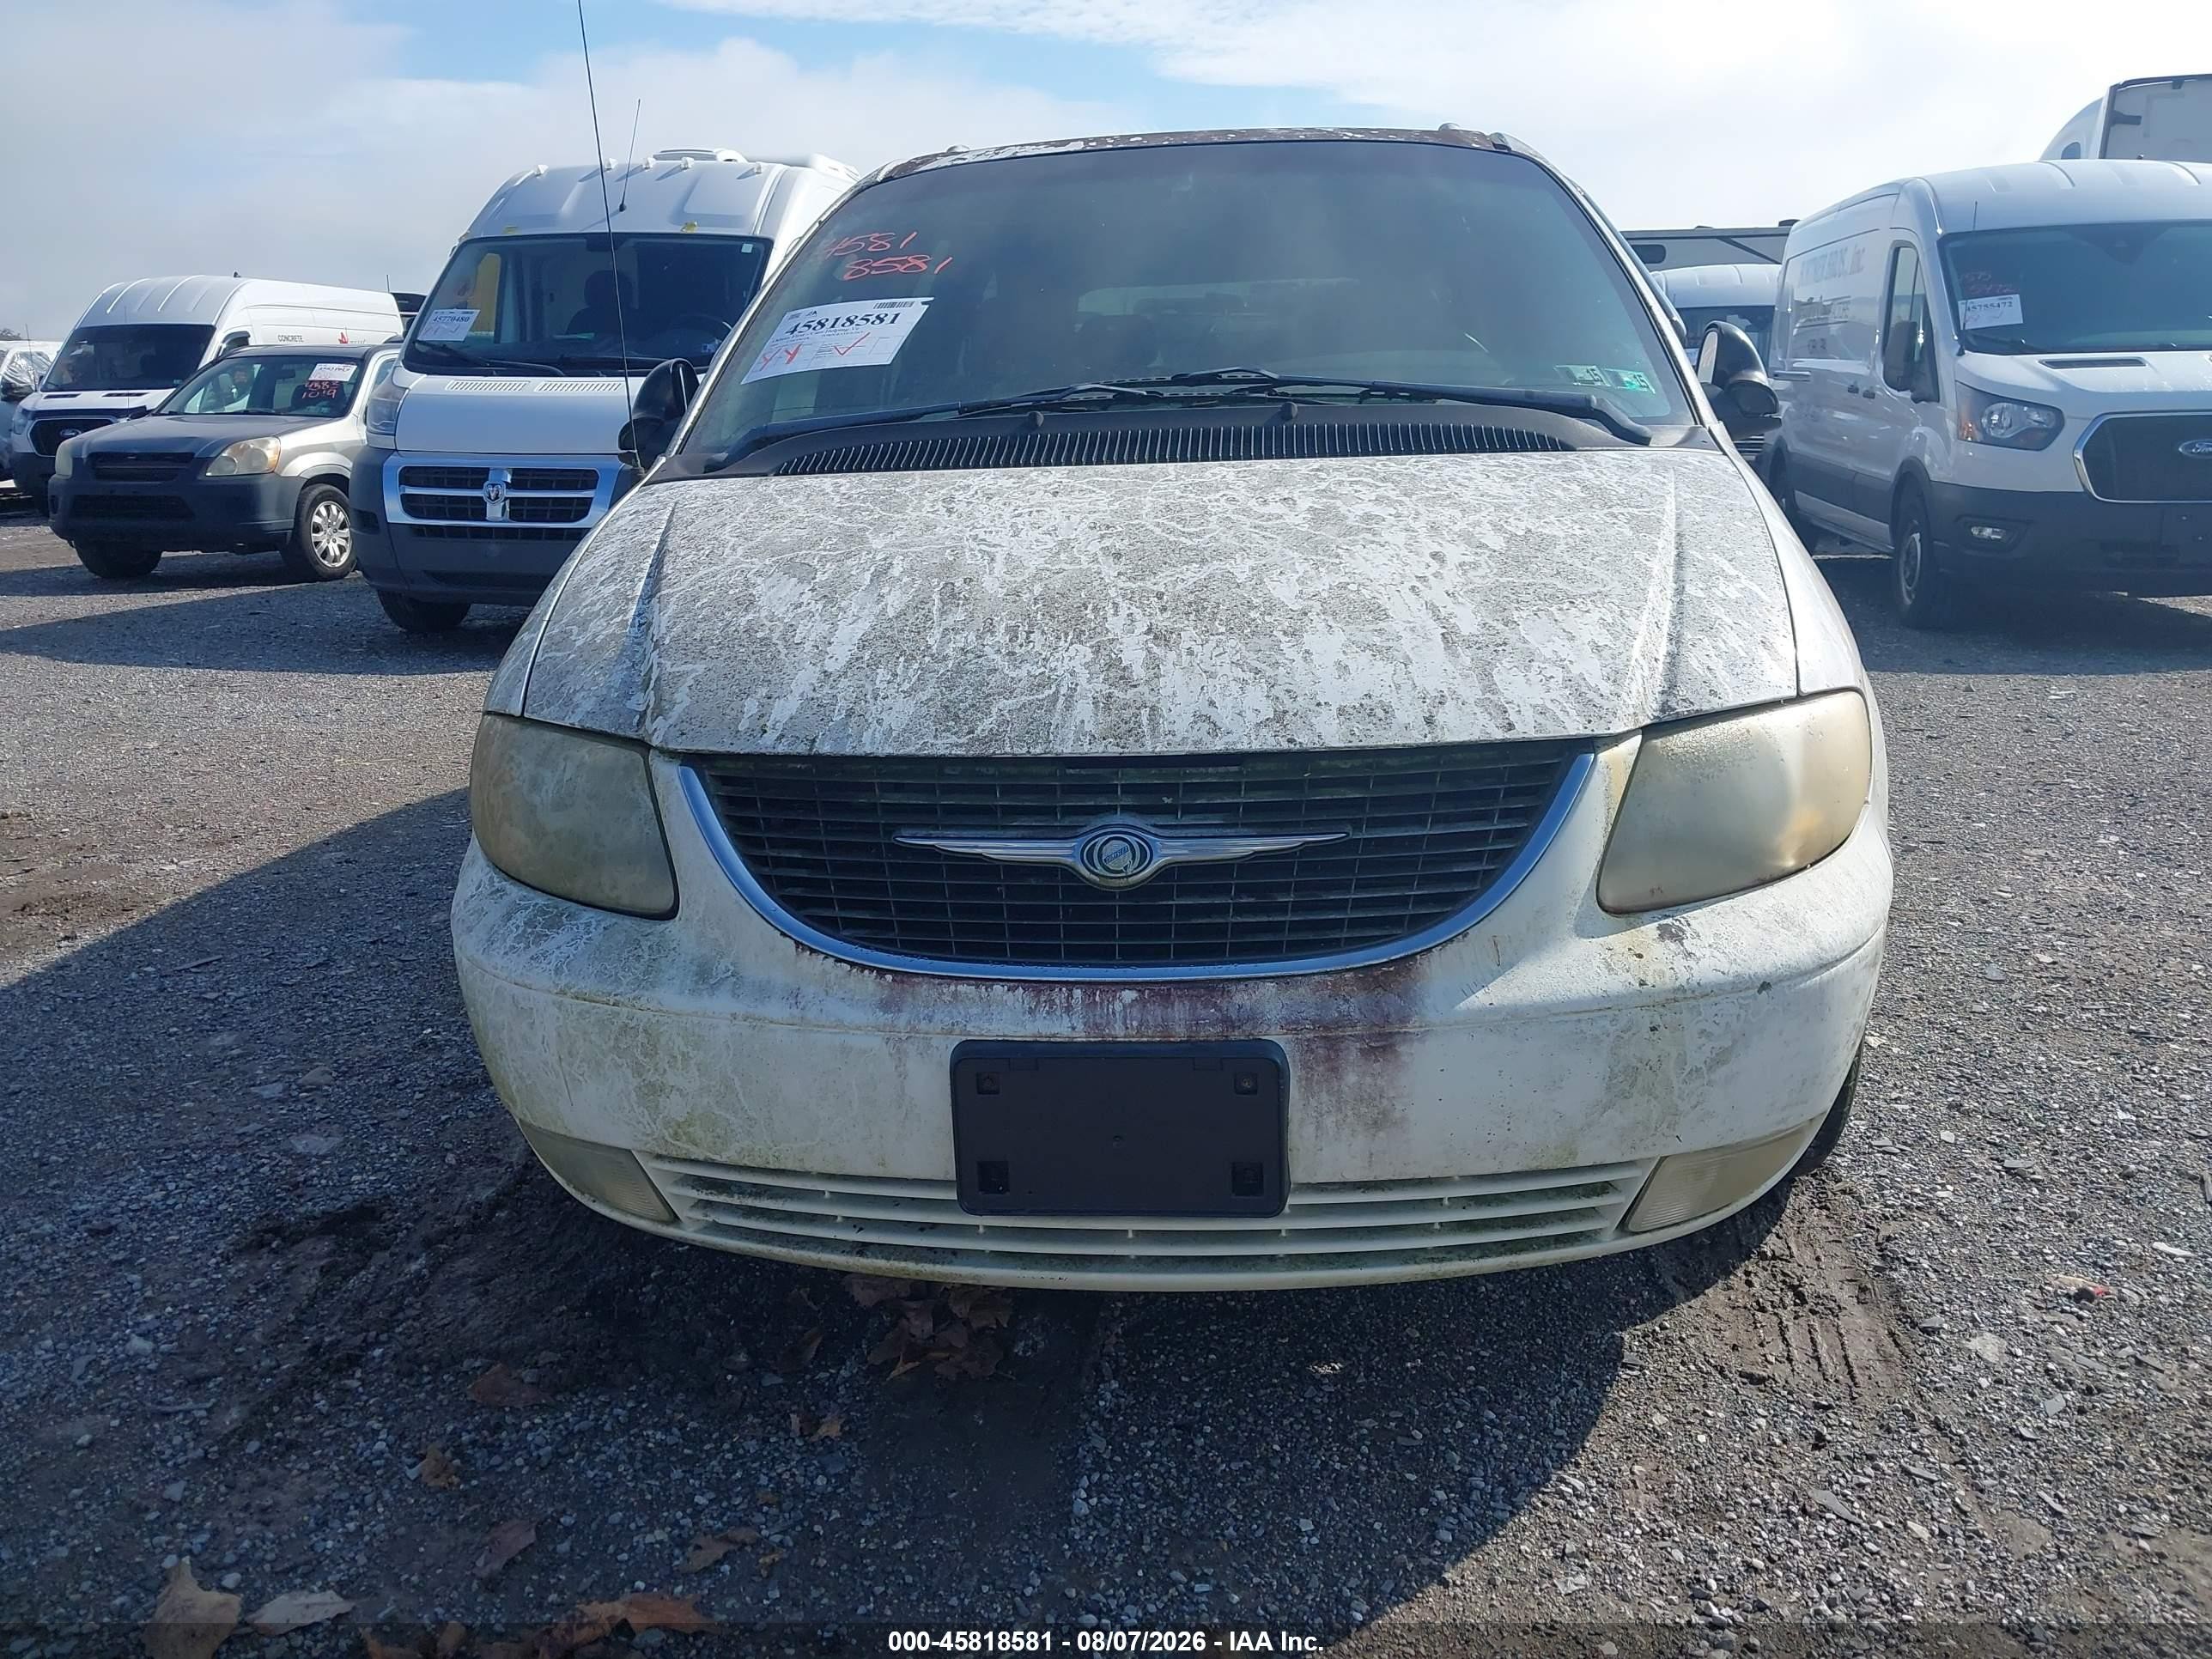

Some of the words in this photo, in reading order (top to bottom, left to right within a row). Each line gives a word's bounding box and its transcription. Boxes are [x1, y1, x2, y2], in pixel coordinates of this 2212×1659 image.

[824, 232, 918, 259] 4581
[842, 254, 953, 281] 8581
[785, 313, 901, 336] 45818581
